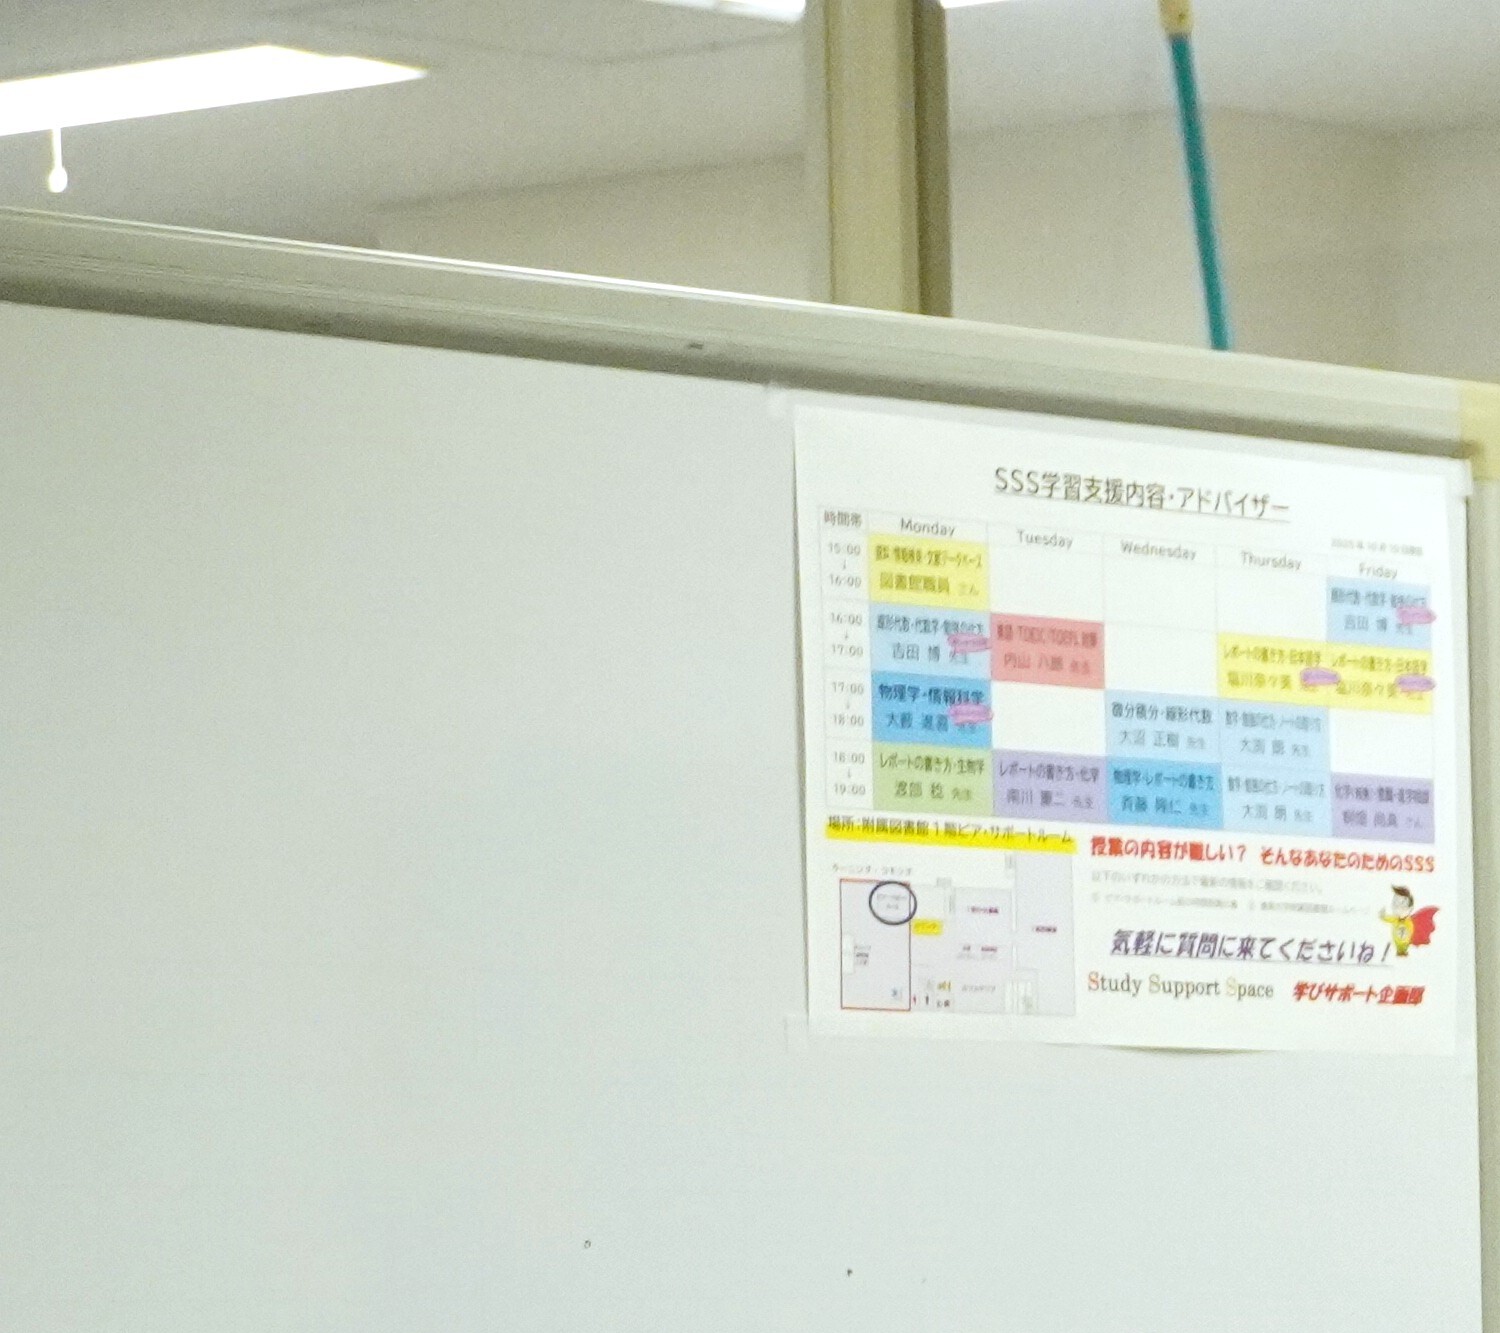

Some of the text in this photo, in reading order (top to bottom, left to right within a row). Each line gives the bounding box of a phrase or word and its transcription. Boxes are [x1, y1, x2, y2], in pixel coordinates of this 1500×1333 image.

[994, 466, 1290, 517] SSS学習支援内容・アドバイザー
[900, 517, 956, 537] Monday
[1017, 529, 1074, 549] Tuesday
[1120, 538, 1197, 562] Wednesday
[1240, 551, 1303, 570] Thursday
[1358, 561, 1398, 580] Friday
[1259, 845, 1436, 873] そんなあなたのためのSSS
[1110, 928, 1392, 964] 気軽に質問に来てくださいね！
[1087, 971, 1275, 1001] Study Support Space
